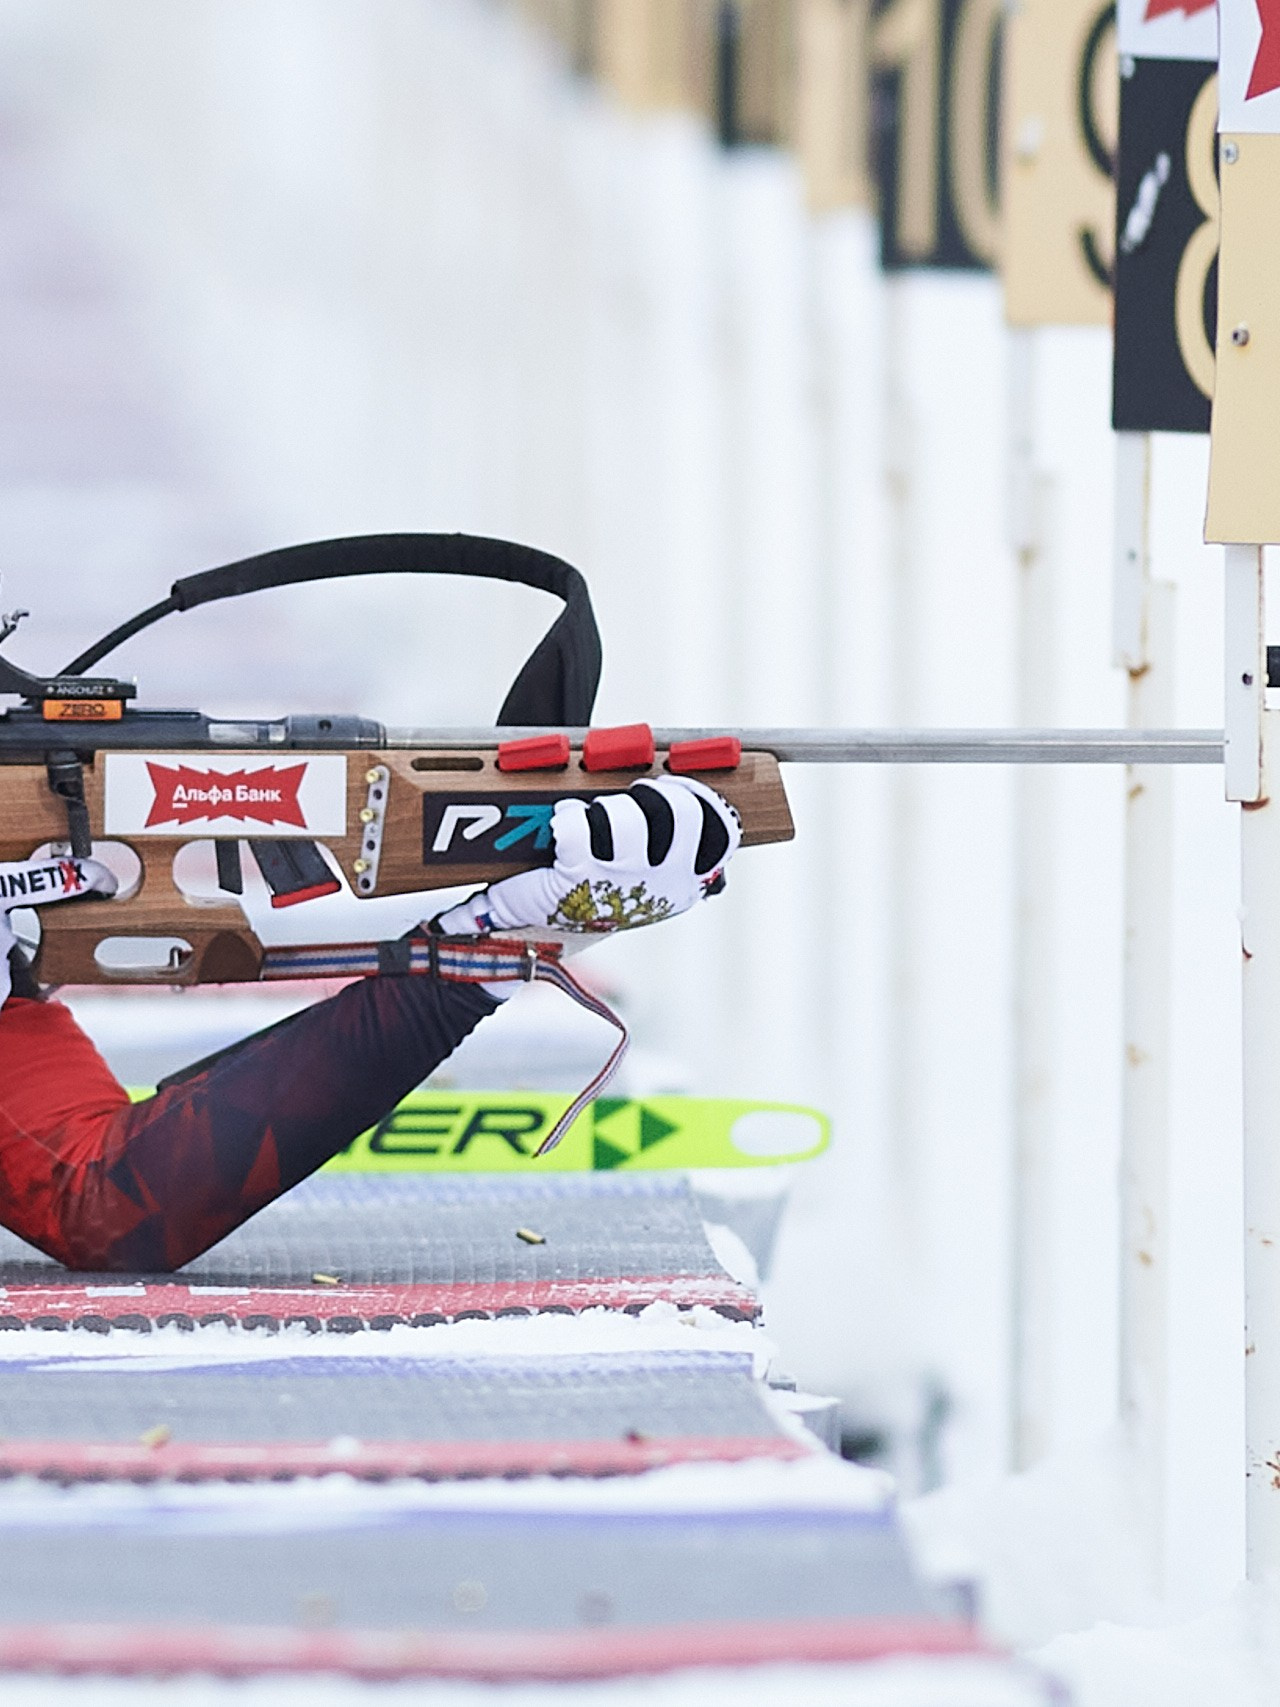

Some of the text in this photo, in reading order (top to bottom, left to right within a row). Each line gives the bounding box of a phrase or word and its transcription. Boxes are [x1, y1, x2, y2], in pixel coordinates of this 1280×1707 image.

[59, 703, 106, 717] ZERO
[172, 784, 281, 808] Альфа Банк
